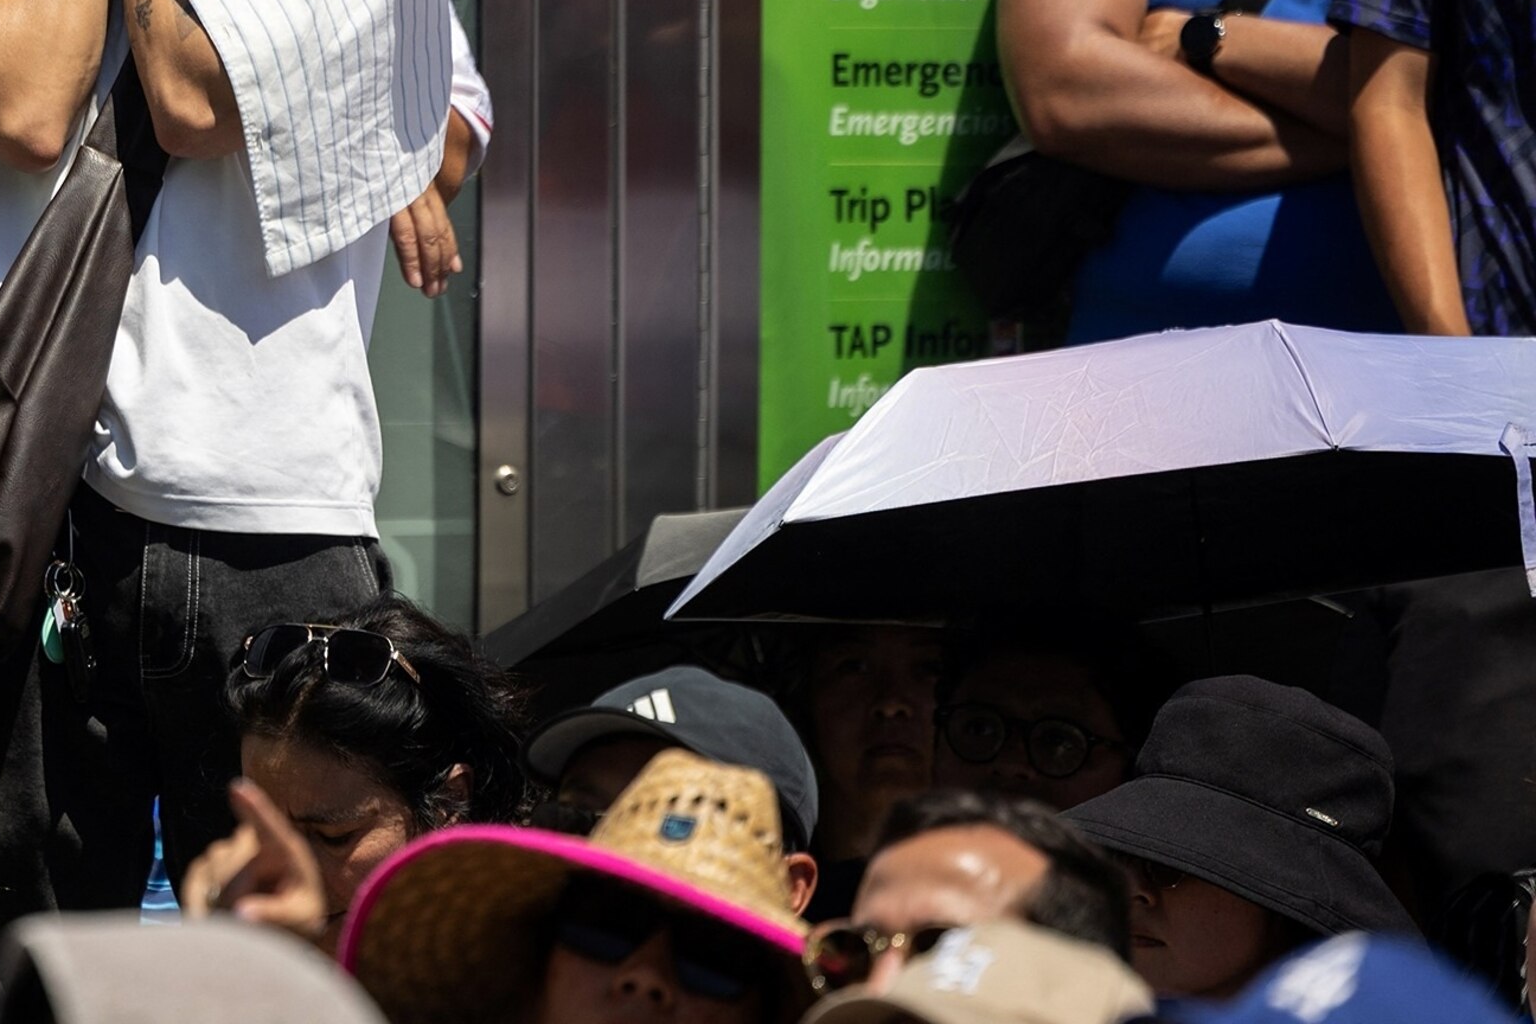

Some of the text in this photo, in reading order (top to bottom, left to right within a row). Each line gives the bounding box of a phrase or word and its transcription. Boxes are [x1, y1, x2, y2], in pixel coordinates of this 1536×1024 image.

[832, 53, 1004, 98] Emergenc
[829, 187, 890, 234] Trip
[829, 324, 891, 360] TAP
